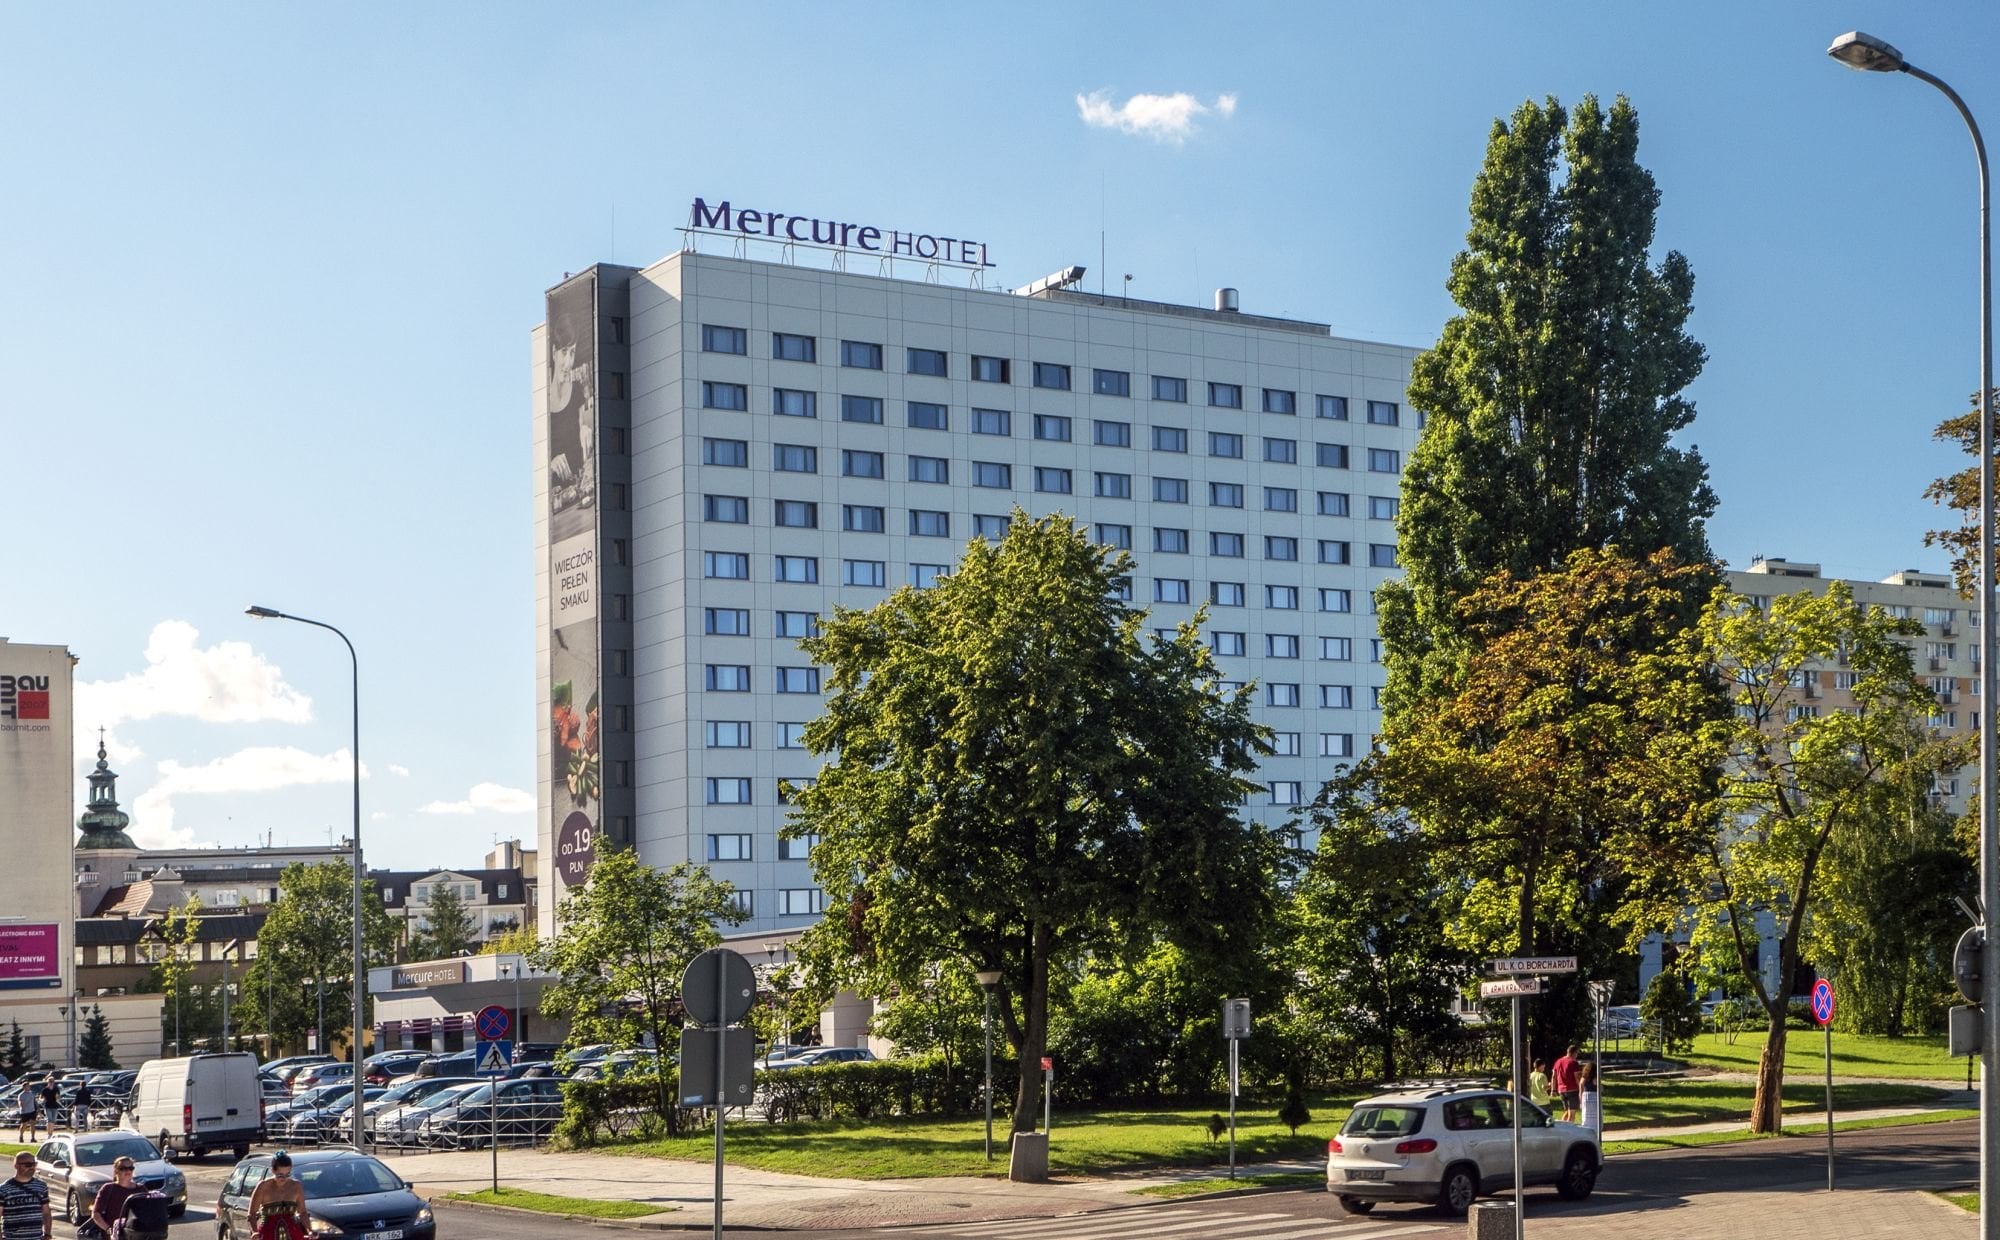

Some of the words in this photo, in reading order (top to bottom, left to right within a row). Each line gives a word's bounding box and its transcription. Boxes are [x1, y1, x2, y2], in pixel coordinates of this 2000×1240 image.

[693, 197, 881, 251] Mercure
[893, 230, 997, 267] HOTEL
[554, 547, 593, 575] WIECZÓR
[561, 571, 588, 592] PEŁEN
[560, 589, 589, 611] SMAKU
[561, 843, 573, 855] OD
[574, 828, 591, 853] 19
[569, 861, 584, 874] PLN
[1526, 960, 1575, 969] BORCHARDTA
[398, 970, 433, 985] Mercure
[434, 969, 456, 981] HOTEL
[1505, 982, 1537, 992] KRAJOWEJ
